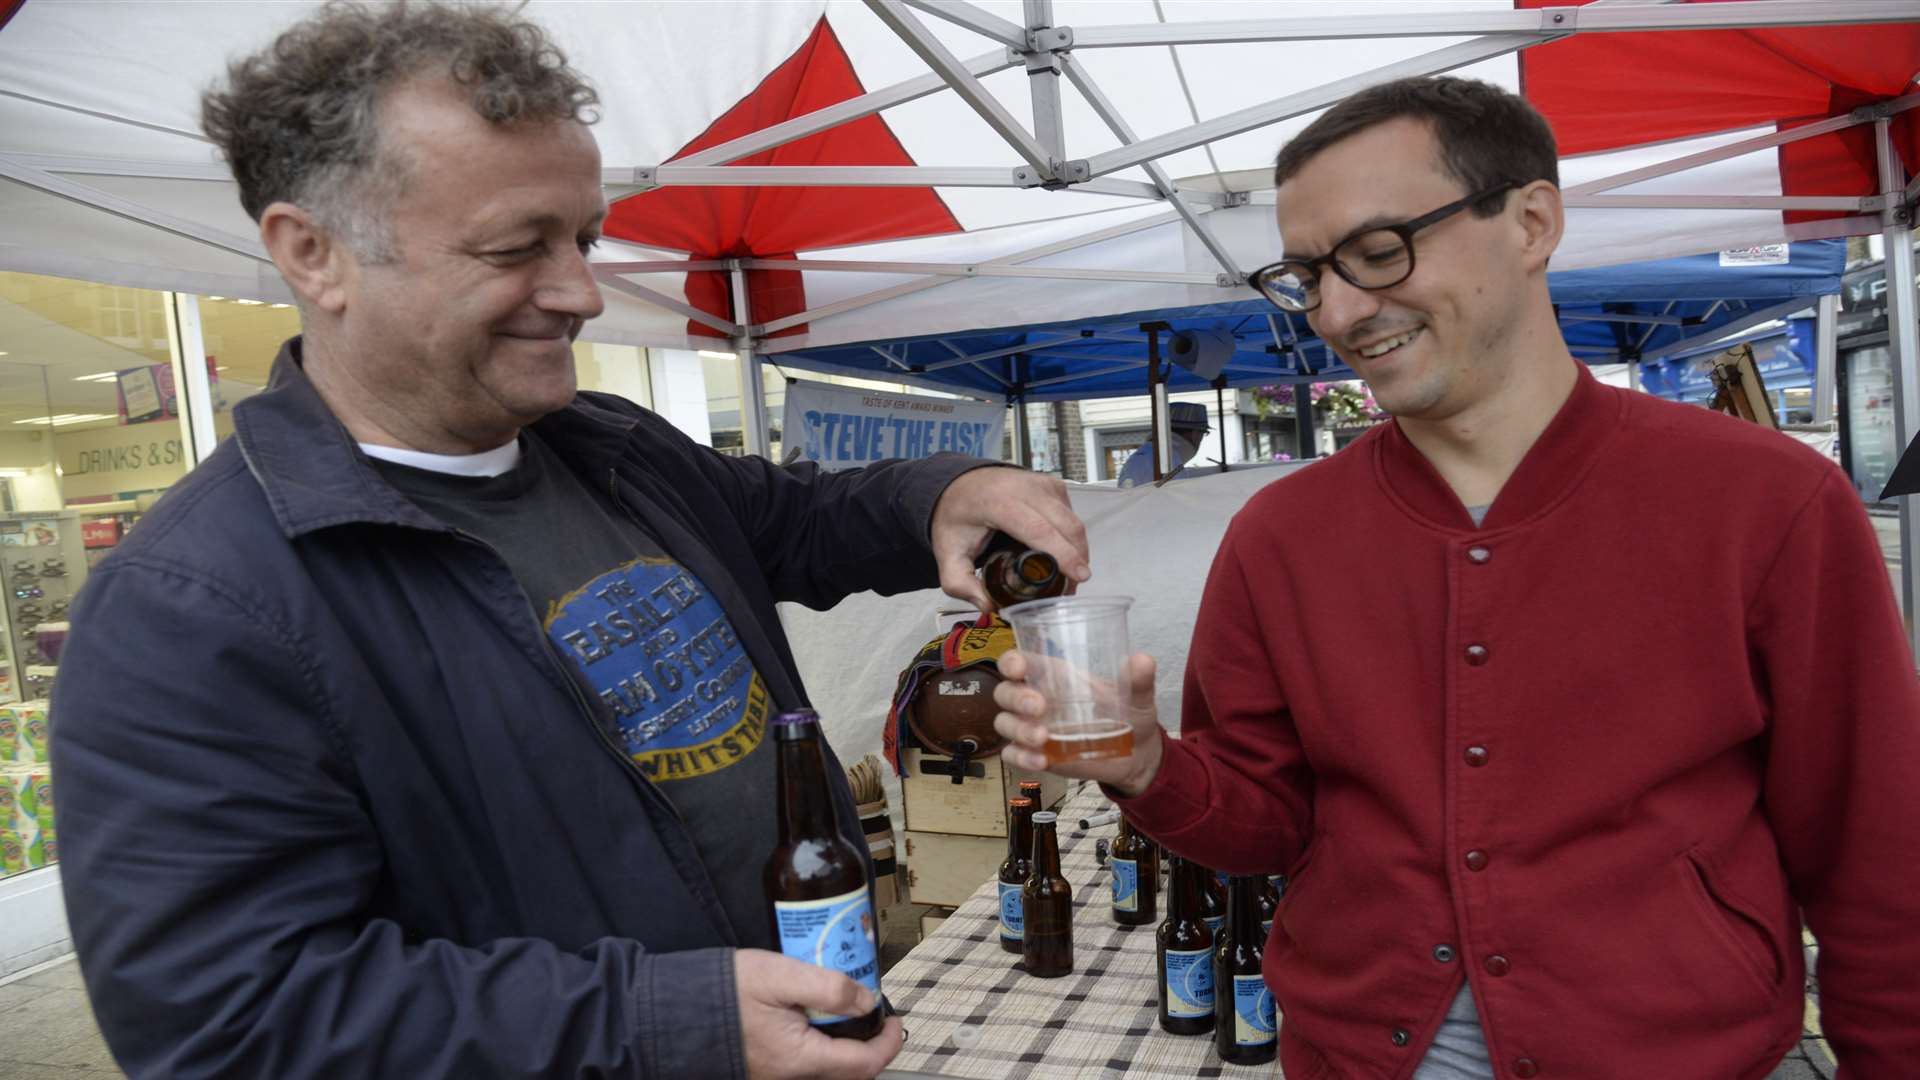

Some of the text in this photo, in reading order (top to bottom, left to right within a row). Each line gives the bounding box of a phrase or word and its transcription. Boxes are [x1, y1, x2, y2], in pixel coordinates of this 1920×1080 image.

[805, 410, 883, 461] STEVE
[79, 445, 141, 472] DRINKS
[147, 442, 160, 466] &
[596, 578, 636, 606] THE
